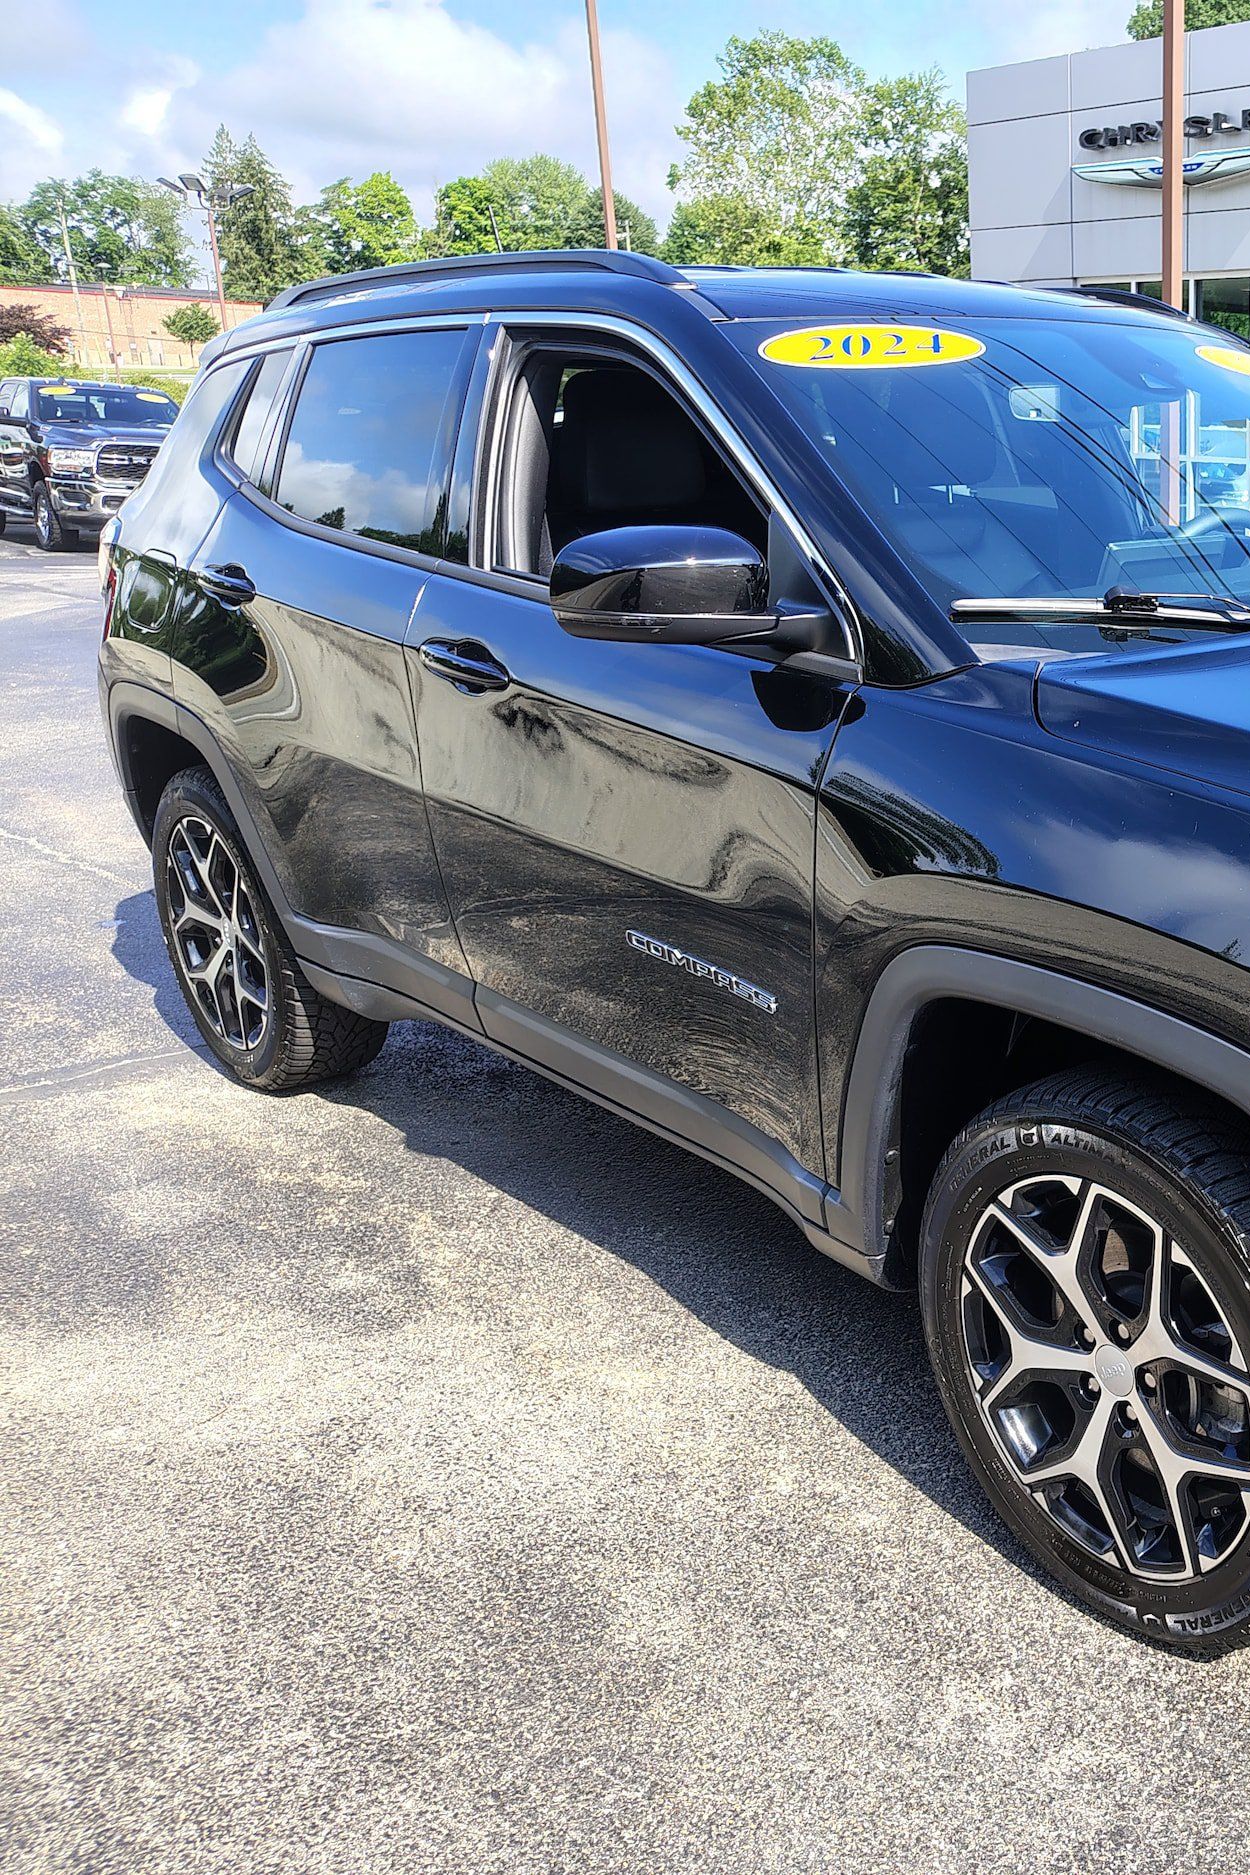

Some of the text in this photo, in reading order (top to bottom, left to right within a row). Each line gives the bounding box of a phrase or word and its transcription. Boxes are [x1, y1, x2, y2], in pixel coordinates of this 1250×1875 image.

[806, 333, 945, 361] 2024
[625, 929, 778, 1014] COMPASS
[1100, 1362, 1126, 1379] Jeep
